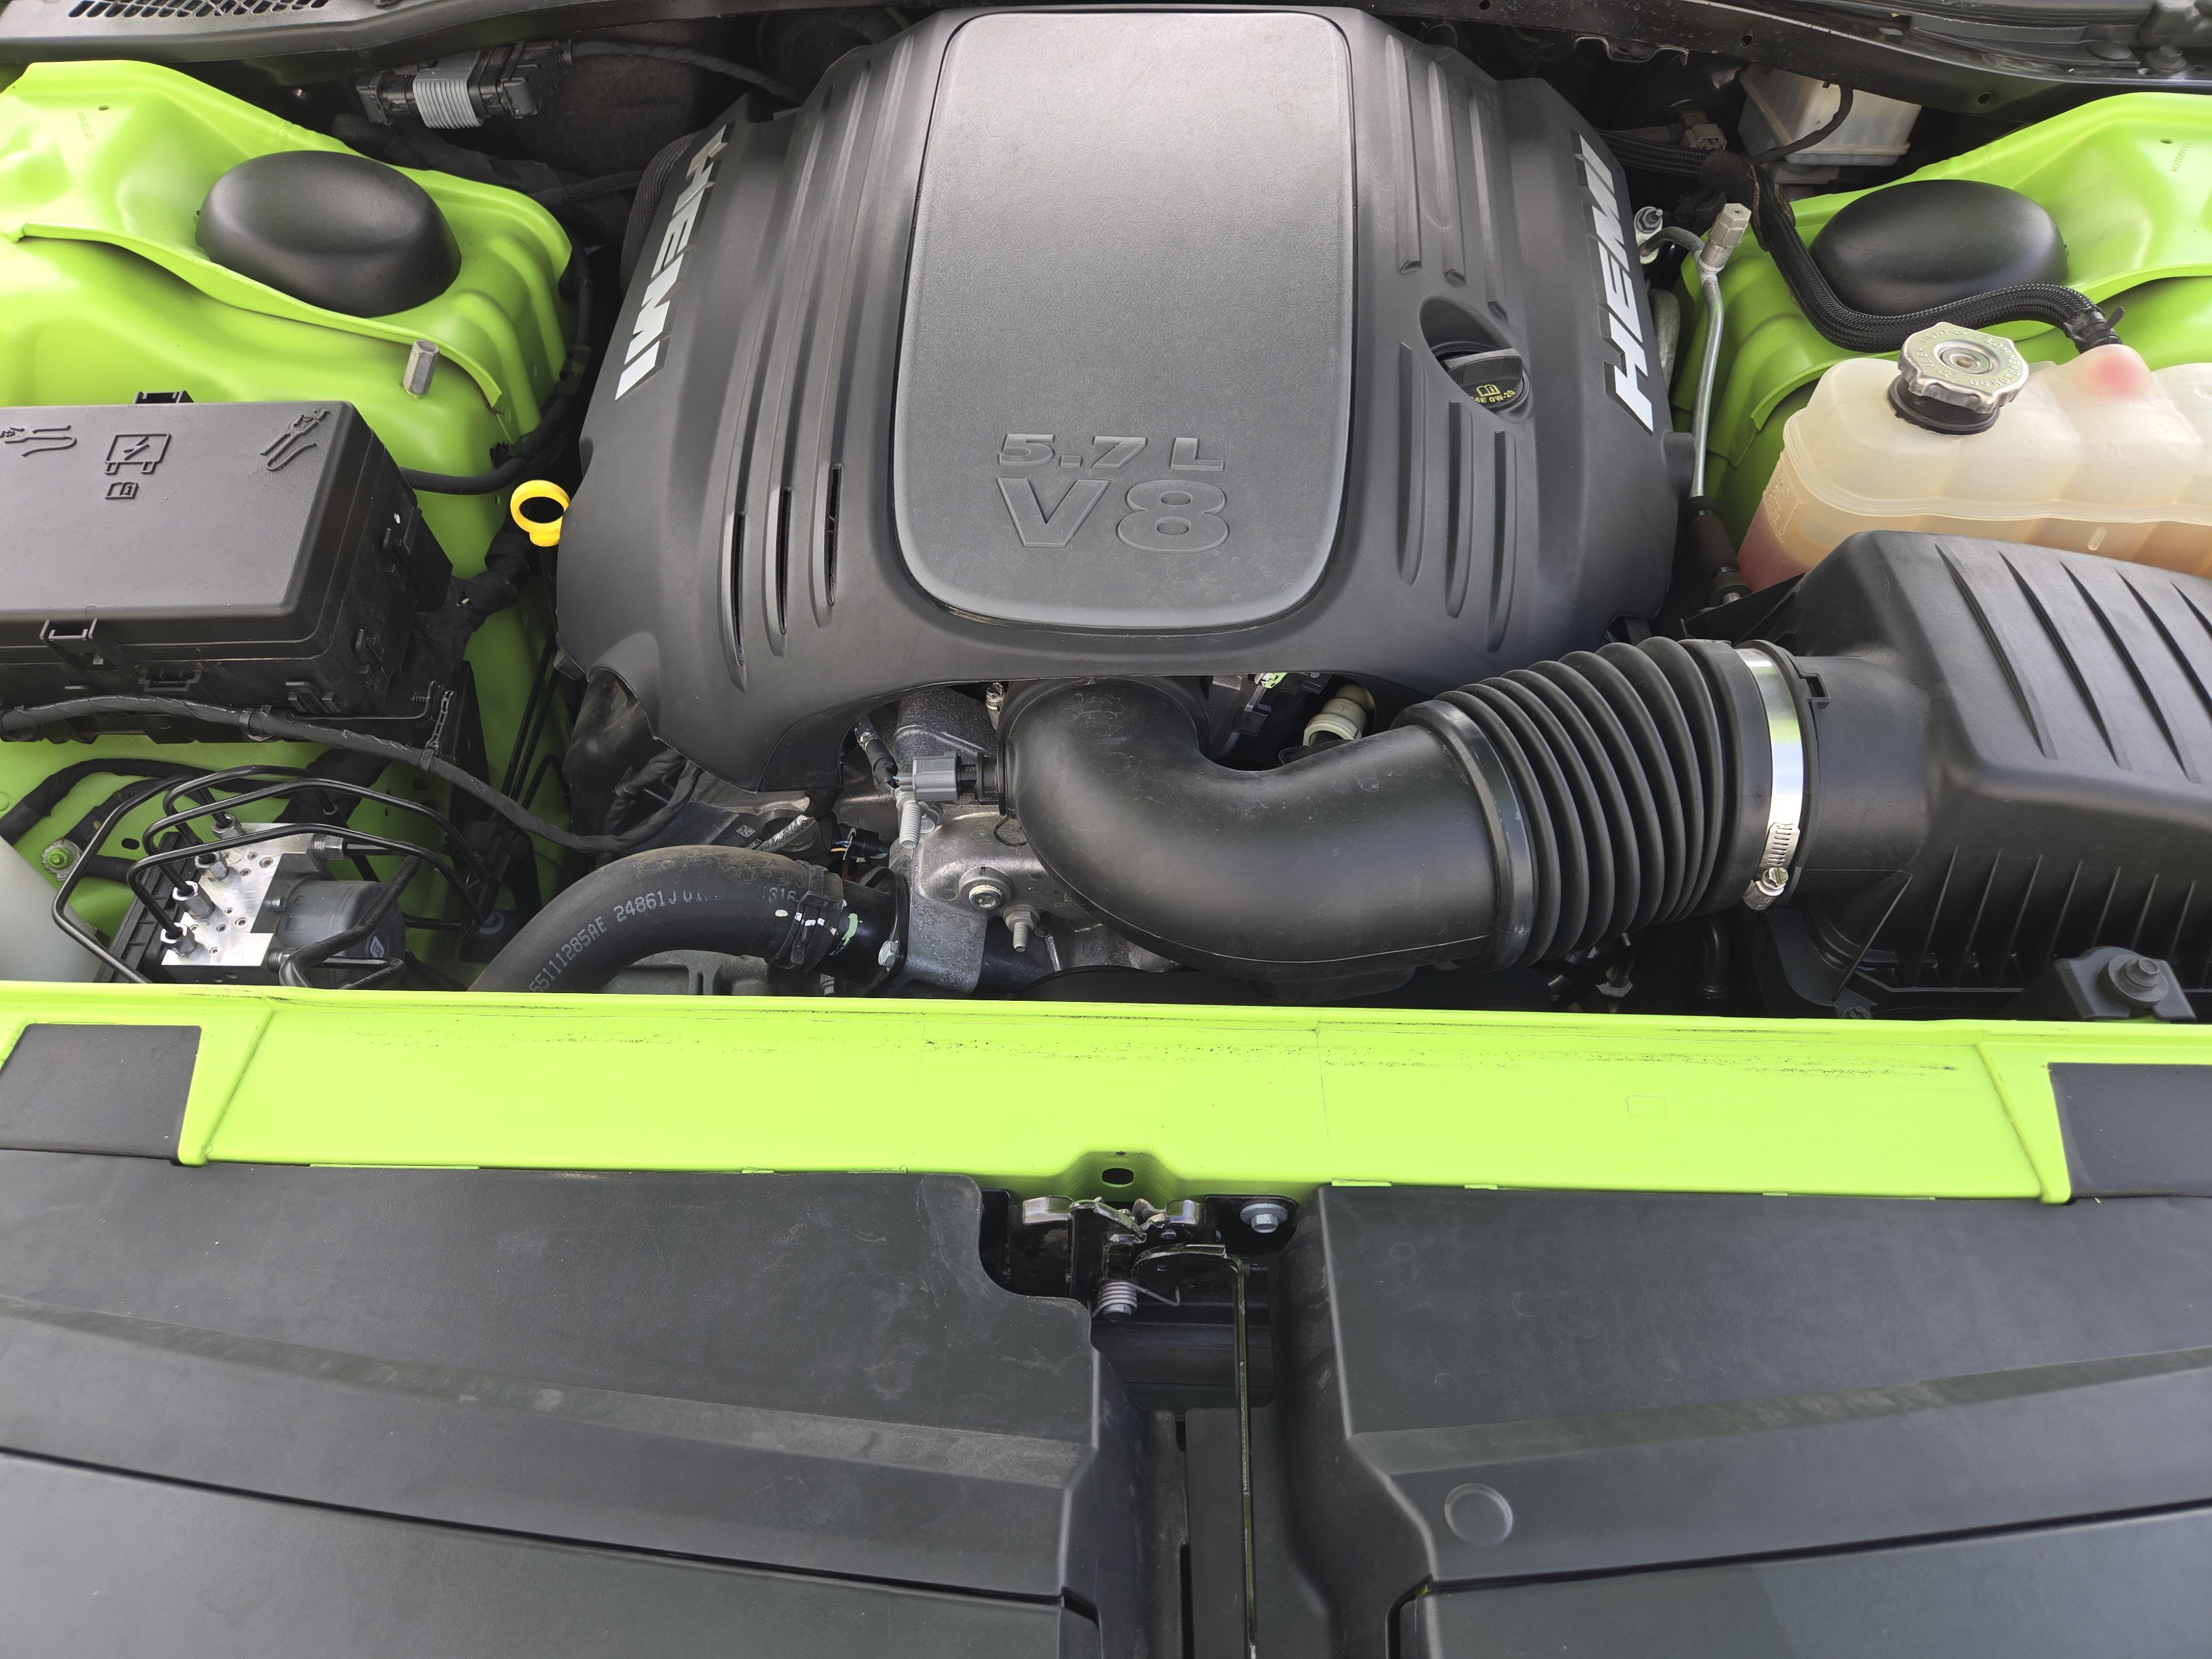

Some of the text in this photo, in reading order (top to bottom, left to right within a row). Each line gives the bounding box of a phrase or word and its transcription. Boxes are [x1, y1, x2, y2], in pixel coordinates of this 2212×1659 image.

[615, 124, 727, 401] HEMI
[1579, 133, 1653, 432] HEMI
[1489, 390, 1515, 403] 0W-20
[998, 433, 1225, 471] 5.7 L
[995, 477, 1230, 554] V8
